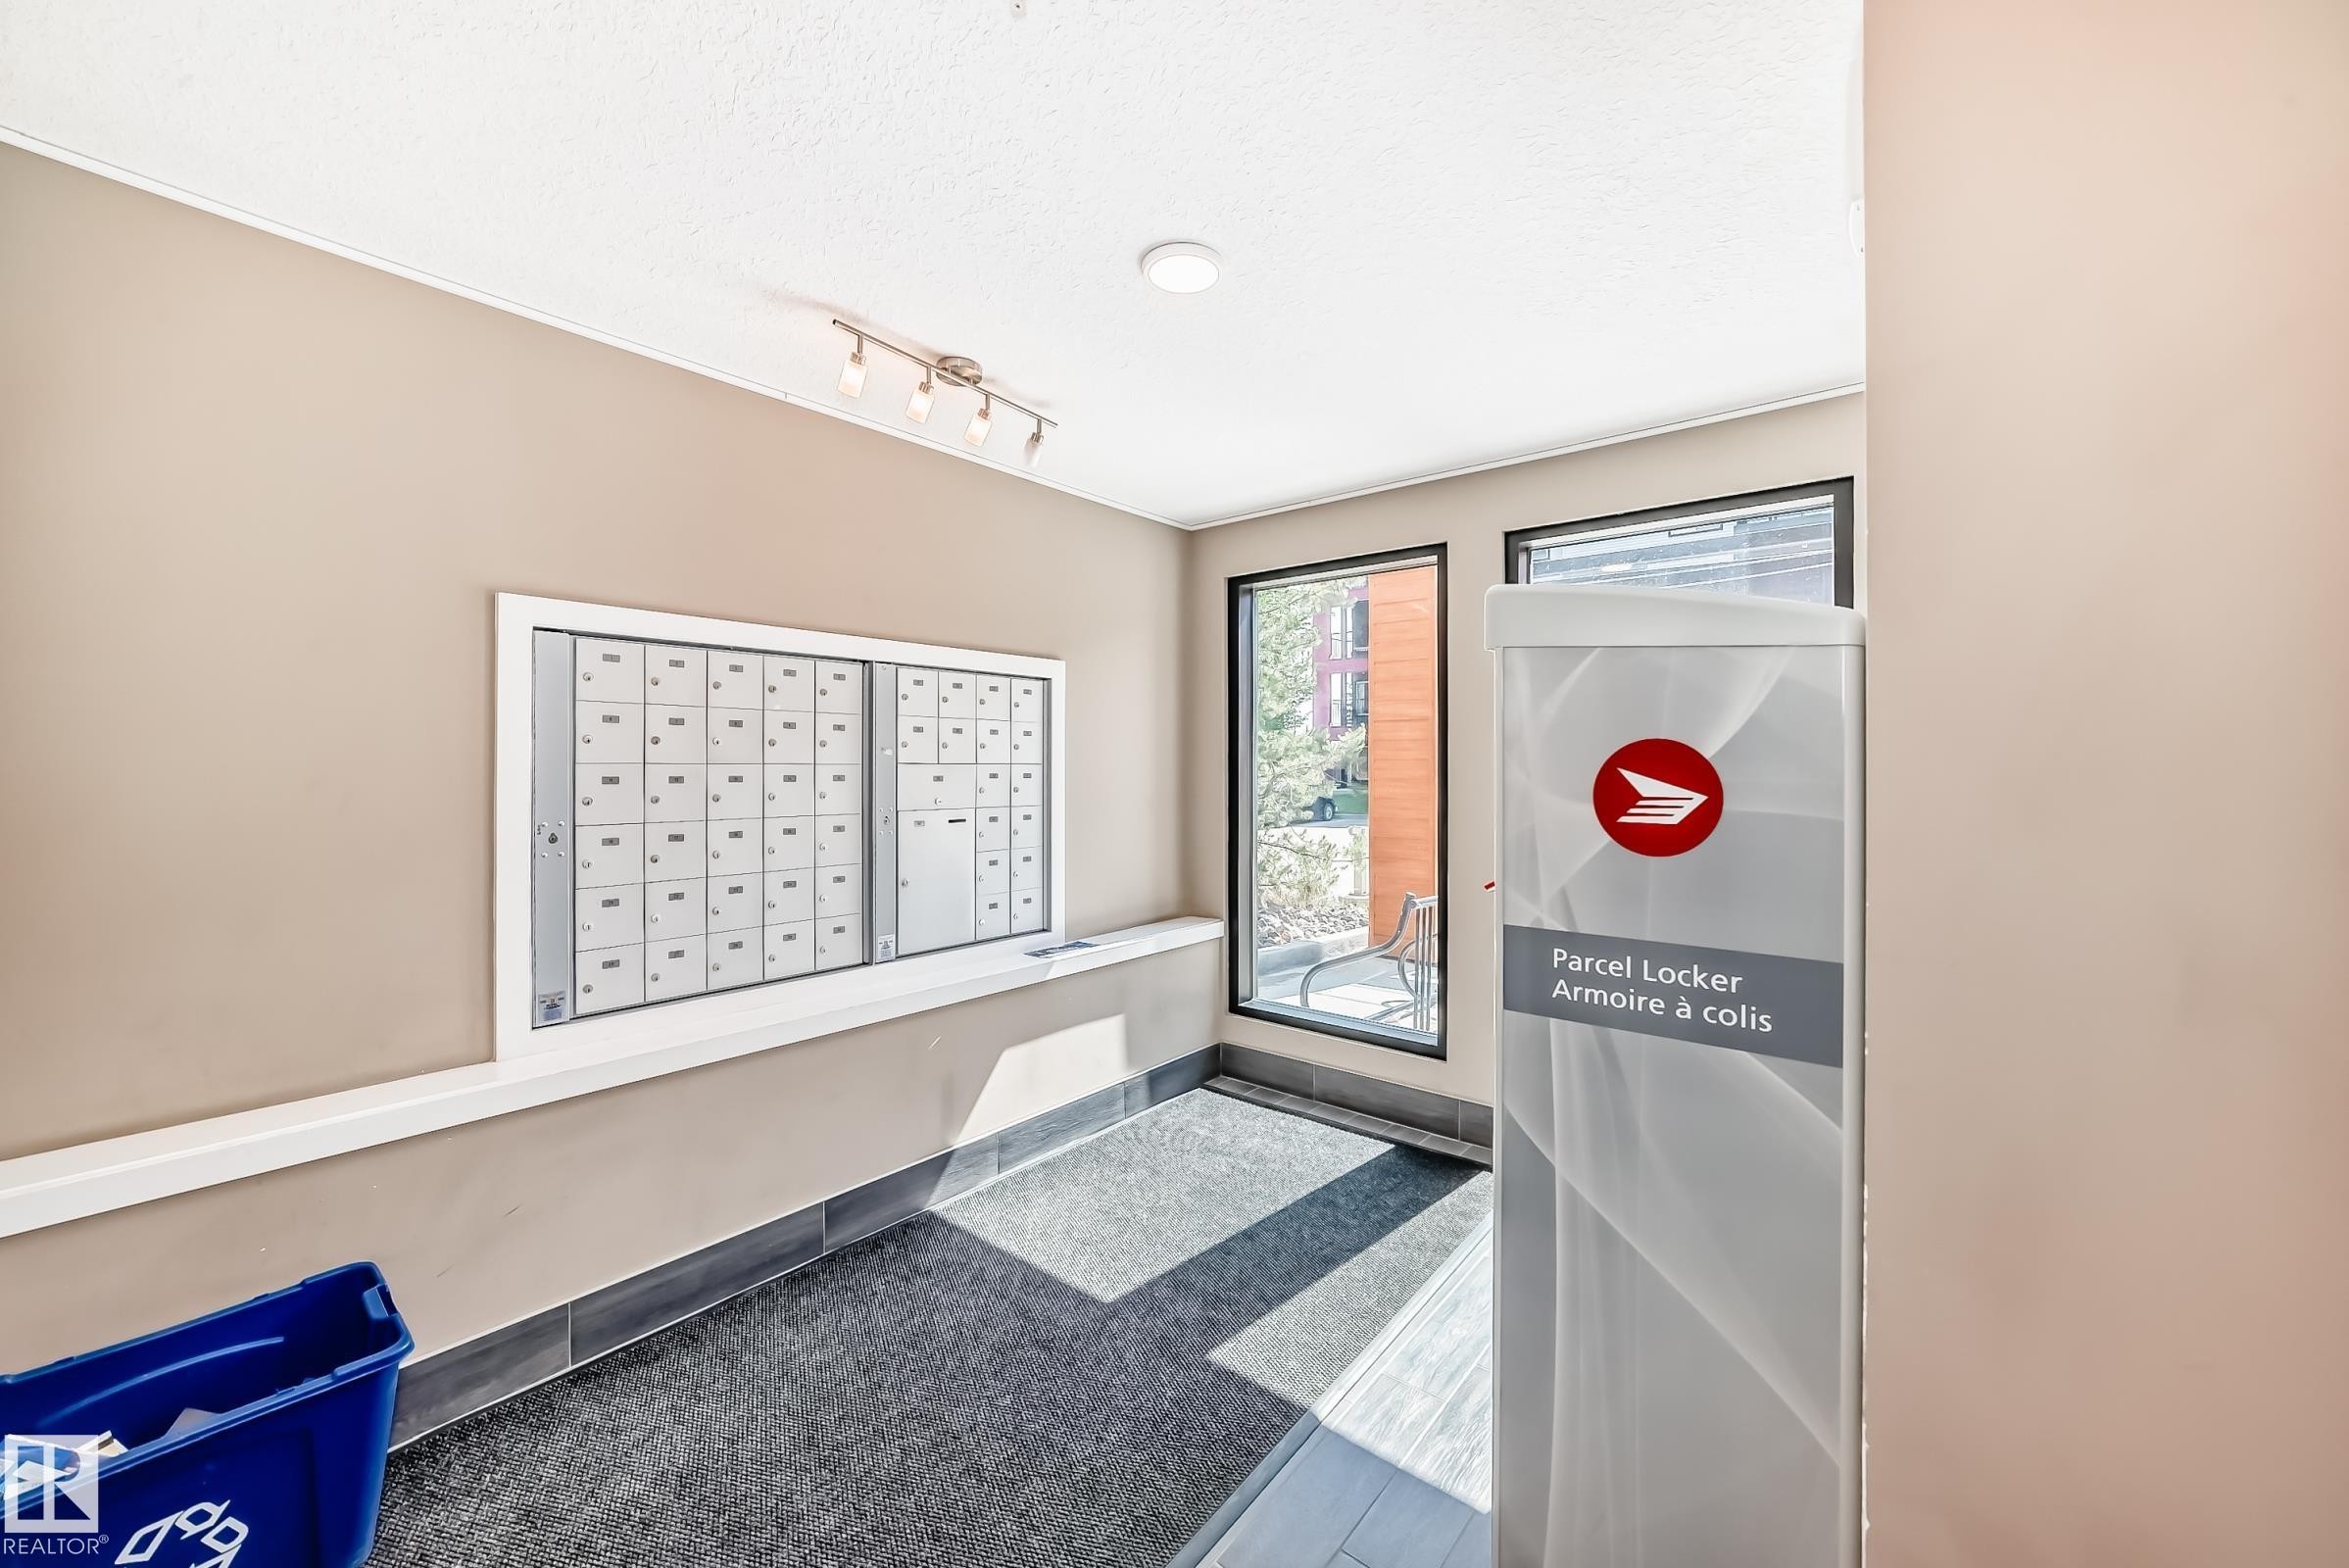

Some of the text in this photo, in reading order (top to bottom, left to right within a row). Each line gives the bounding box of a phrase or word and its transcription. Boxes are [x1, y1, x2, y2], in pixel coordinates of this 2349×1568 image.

[1552, 947, 1743, 994] Parcel Locker
[1551, 978, 1773, 1033] Armoire à colis
